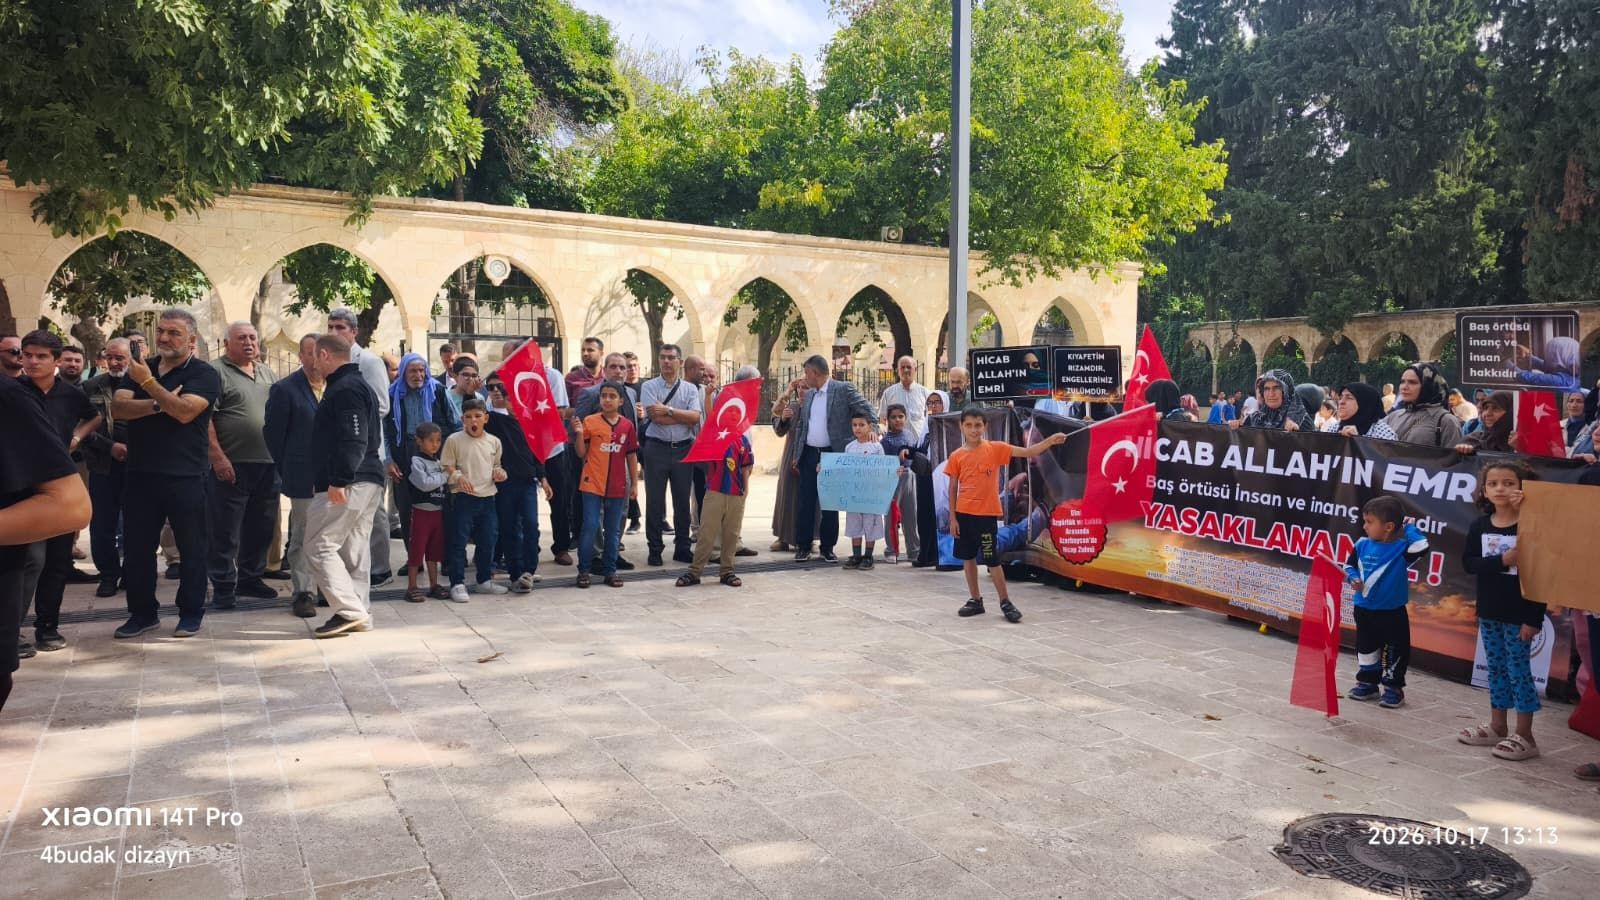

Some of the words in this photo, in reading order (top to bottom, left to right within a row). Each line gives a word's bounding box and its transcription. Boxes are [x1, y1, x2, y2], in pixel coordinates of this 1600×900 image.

[1469, 322, 1490, 333] Baş
[1492, 321, 1530, 331] örtüsü
[1469, 337, 1501, 348] inanç
[1504, 339, 1517, 347] ve
[976, 355, 1010, 365] HİCAB
[1067, 353, 1105, 361] KIYAFETİM
[1469, 352, 1501, 362] insan
[977, 369, 1027, 380] ALLAH'IN
[1469, 367, 1517, 378] hakkıdır
[978, 383, 1005, 394] EMRİ
[1221, 444, 1374, 488] ALLAH'IN
[1383, 463, 1477, 503] EMR
[1146, 475, 1174, 495] Baş
[1179, 479, 1230, 499] örtüsü
[1235, 483, 1281, 507] İnsan
[1286, 496, 1306, 511] ve
[1310, 495, 1359, 524] inanç
